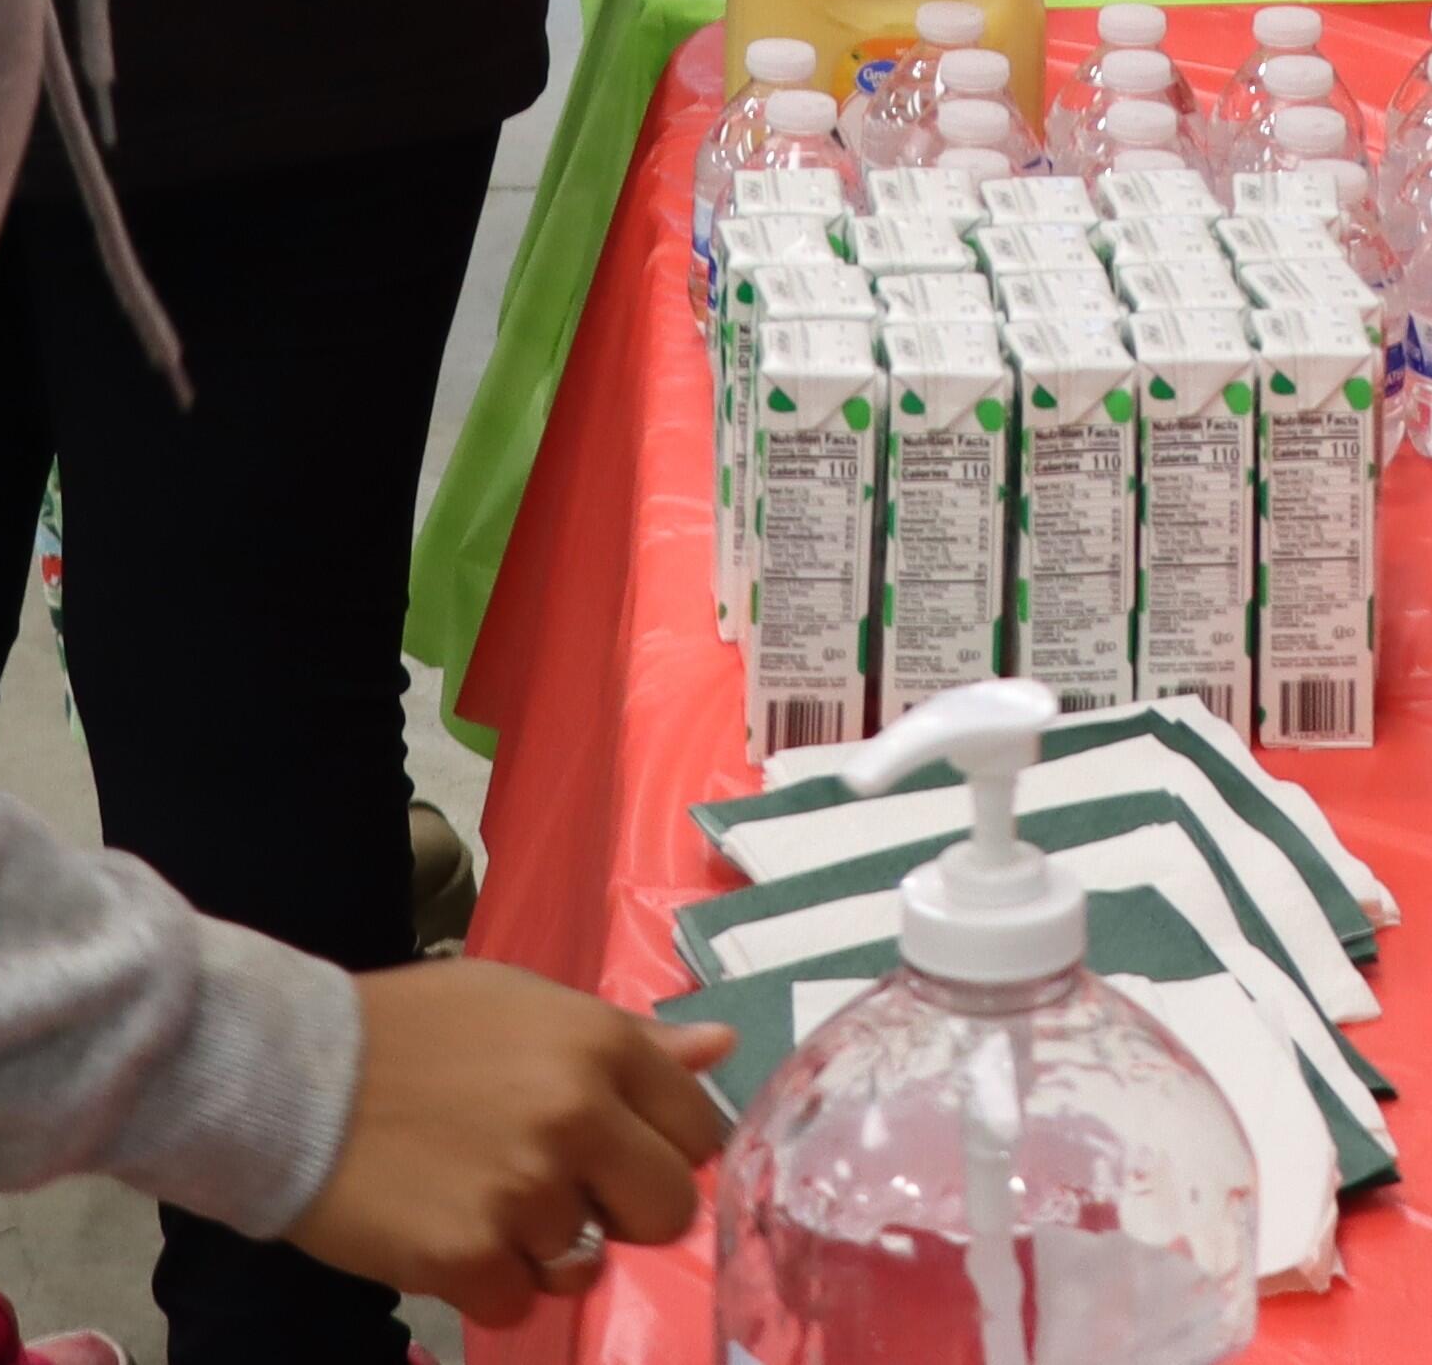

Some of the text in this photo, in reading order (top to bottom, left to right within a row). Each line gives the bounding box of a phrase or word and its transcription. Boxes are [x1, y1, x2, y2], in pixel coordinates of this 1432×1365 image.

[1212, 447, 1239, 464] 110
[1331, 441, 1360, 458] 110
[830, 461, 857, 477] 110
[963, 462, 990, 479] 110
[1094, 454, 1121, 471] 110
